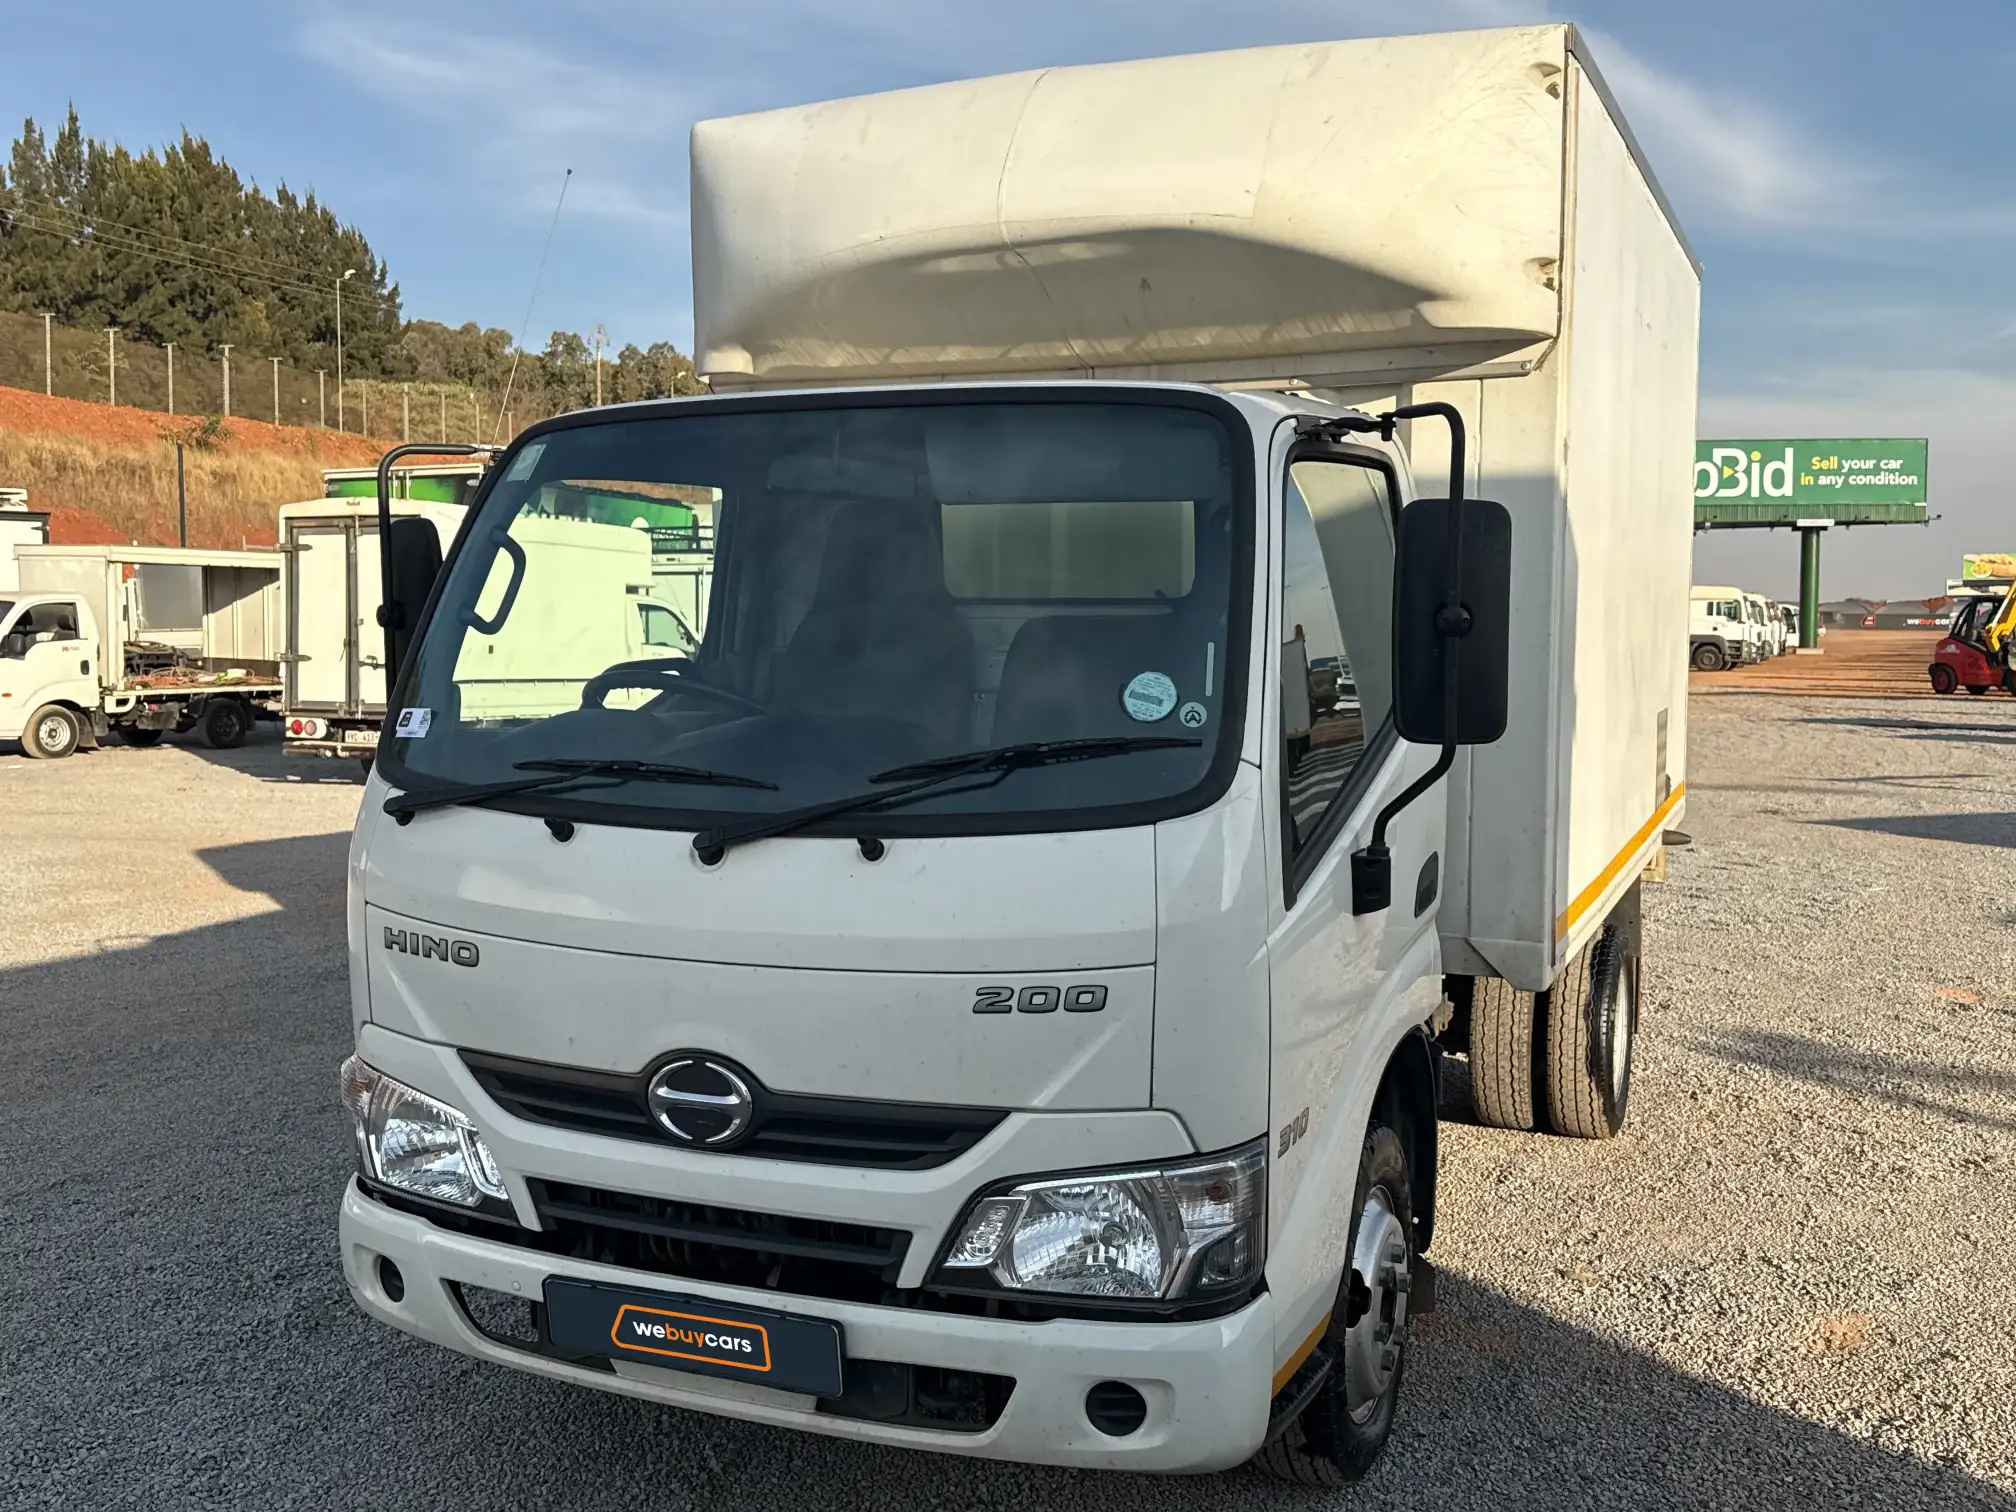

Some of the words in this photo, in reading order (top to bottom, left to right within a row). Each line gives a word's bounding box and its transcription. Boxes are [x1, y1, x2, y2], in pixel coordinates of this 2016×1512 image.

[1811, 456, 1838, 470] Sell
[1841, 459, 1877, 473] your
[1879, 459, 1904, 469] car
[1800, 472, 1814, 485] in
[1817, 475, 1845, 489] any
[1848, 471, 1918, 485] condition
[384, 926, 480, 967] HINO
[972, 985, 1109, 1014] 200
[1278, 1106, 1310, 1159] 310
[633, 1321, 752, 1353] webuycars
